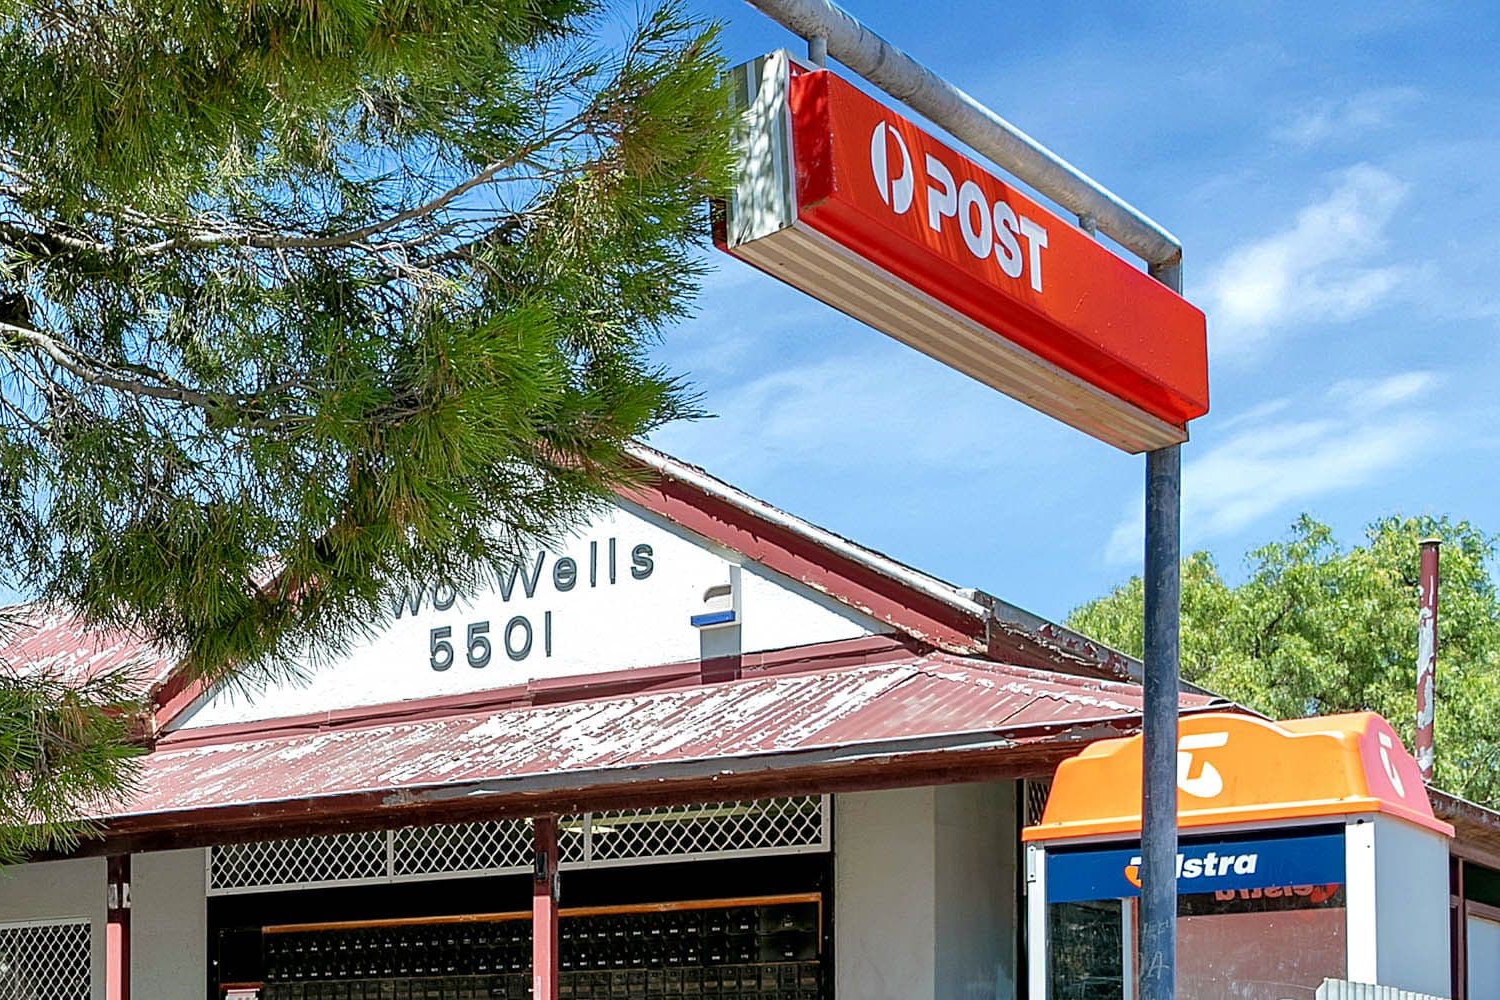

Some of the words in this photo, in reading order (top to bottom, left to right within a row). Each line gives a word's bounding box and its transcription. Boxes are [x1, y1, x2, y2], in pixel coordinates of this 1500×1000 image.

[925, 152, 1047, 292] POST
[496, 537, 654, 602] Wells
[429, 610, 552, 672] 5501
[1124, 852, 1258, 888] Tlstra
